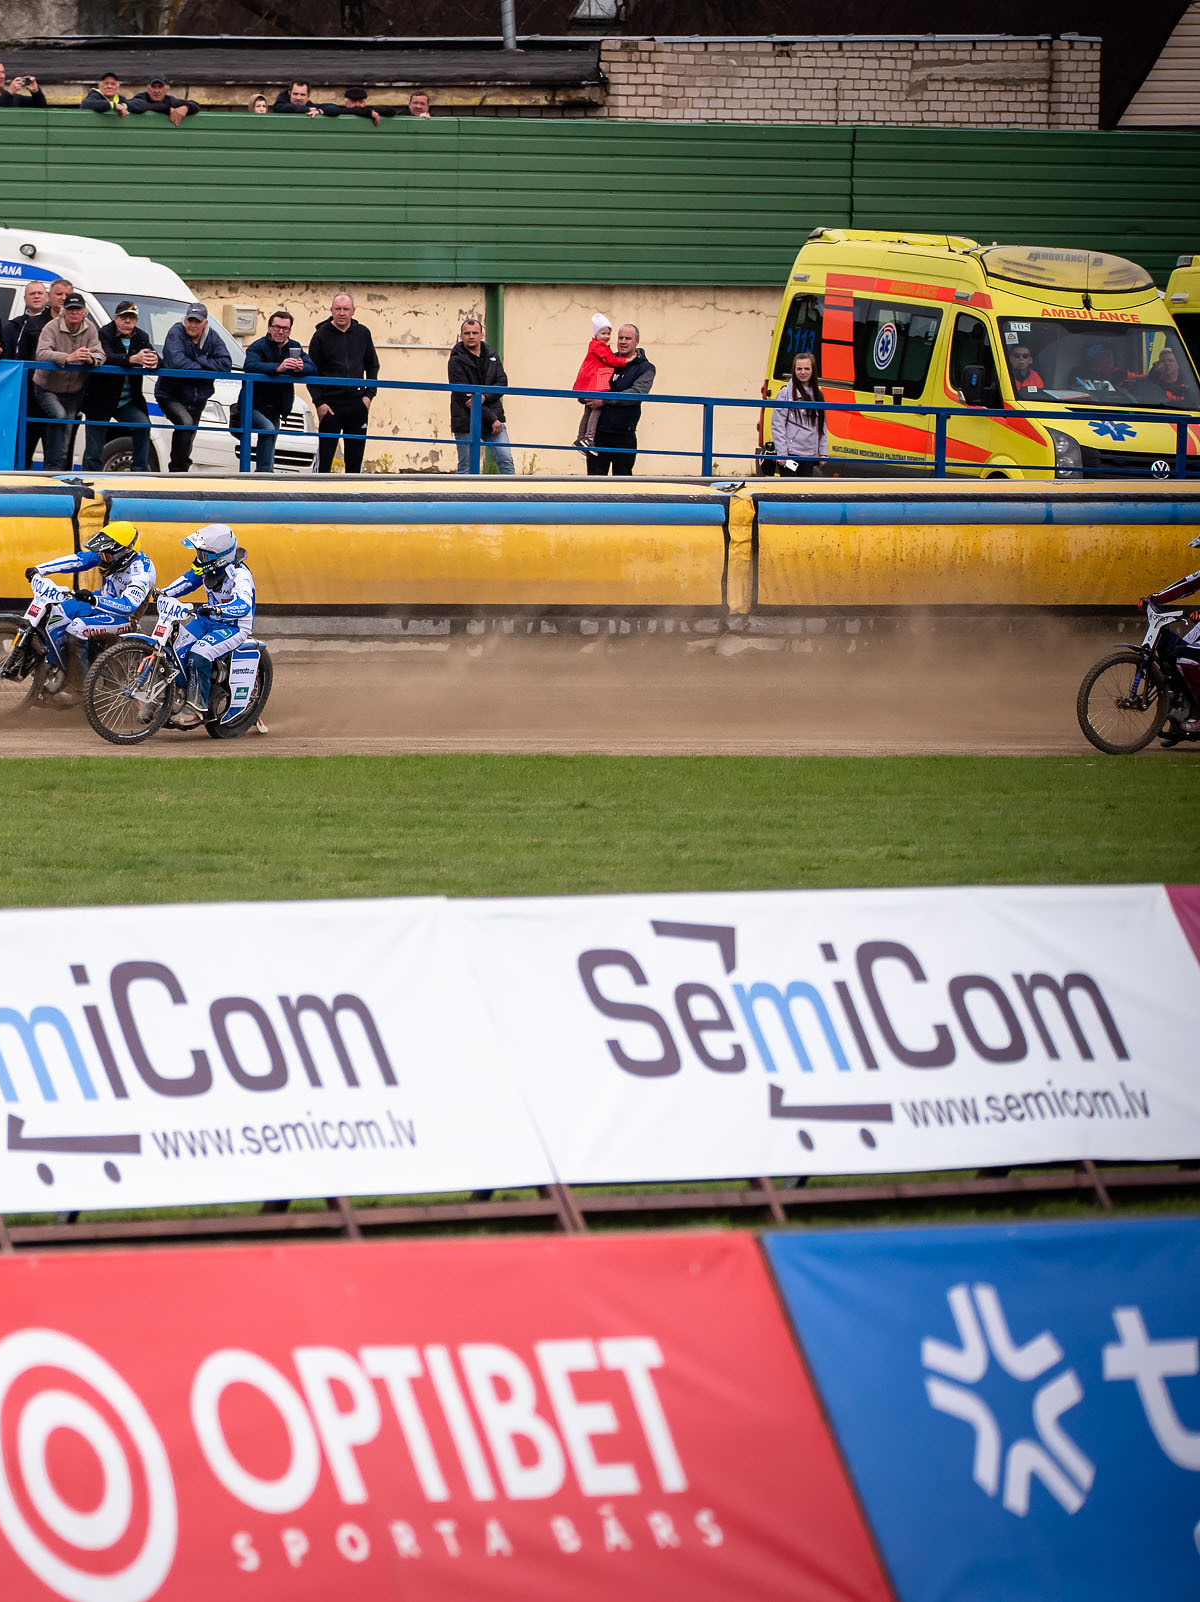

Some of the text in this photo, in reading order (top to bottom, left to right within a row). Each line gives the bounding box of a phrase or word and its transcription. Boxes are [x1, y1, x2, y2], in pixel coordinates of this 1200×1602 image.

[888, 281, 939, 298] AMBULANCE
[1041, 308, 1141, 323] AMBULANCE
[794, 329, 816, 352] 113
[578, 940, 1131, 1078] SemiCom
[902, 1081, 1150, 1129] www.semicom.lv
[152, 1110, 418, 1160] www.semicom.lv
[190, 1337, 689, 1514] OPTIBET
[231, 1504, 725, 1572] SPORTA BĀRS
